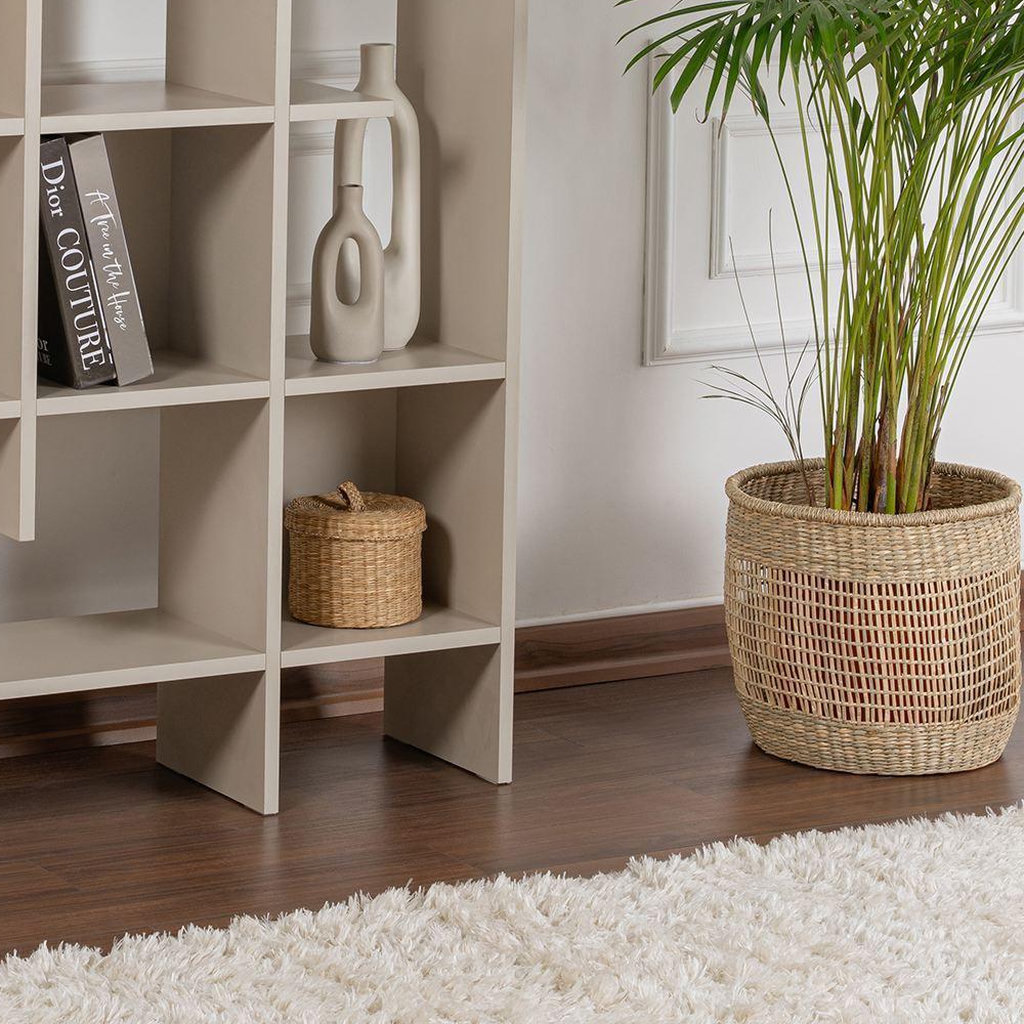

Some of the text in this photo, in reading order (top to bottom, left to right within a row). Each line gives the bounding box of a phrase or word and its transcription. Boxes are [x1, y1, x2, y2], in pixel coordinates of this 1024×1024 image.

[41, 157, 111, 371] Dior COUTURE
[85, 189, 131, 331] A Tree in the House
